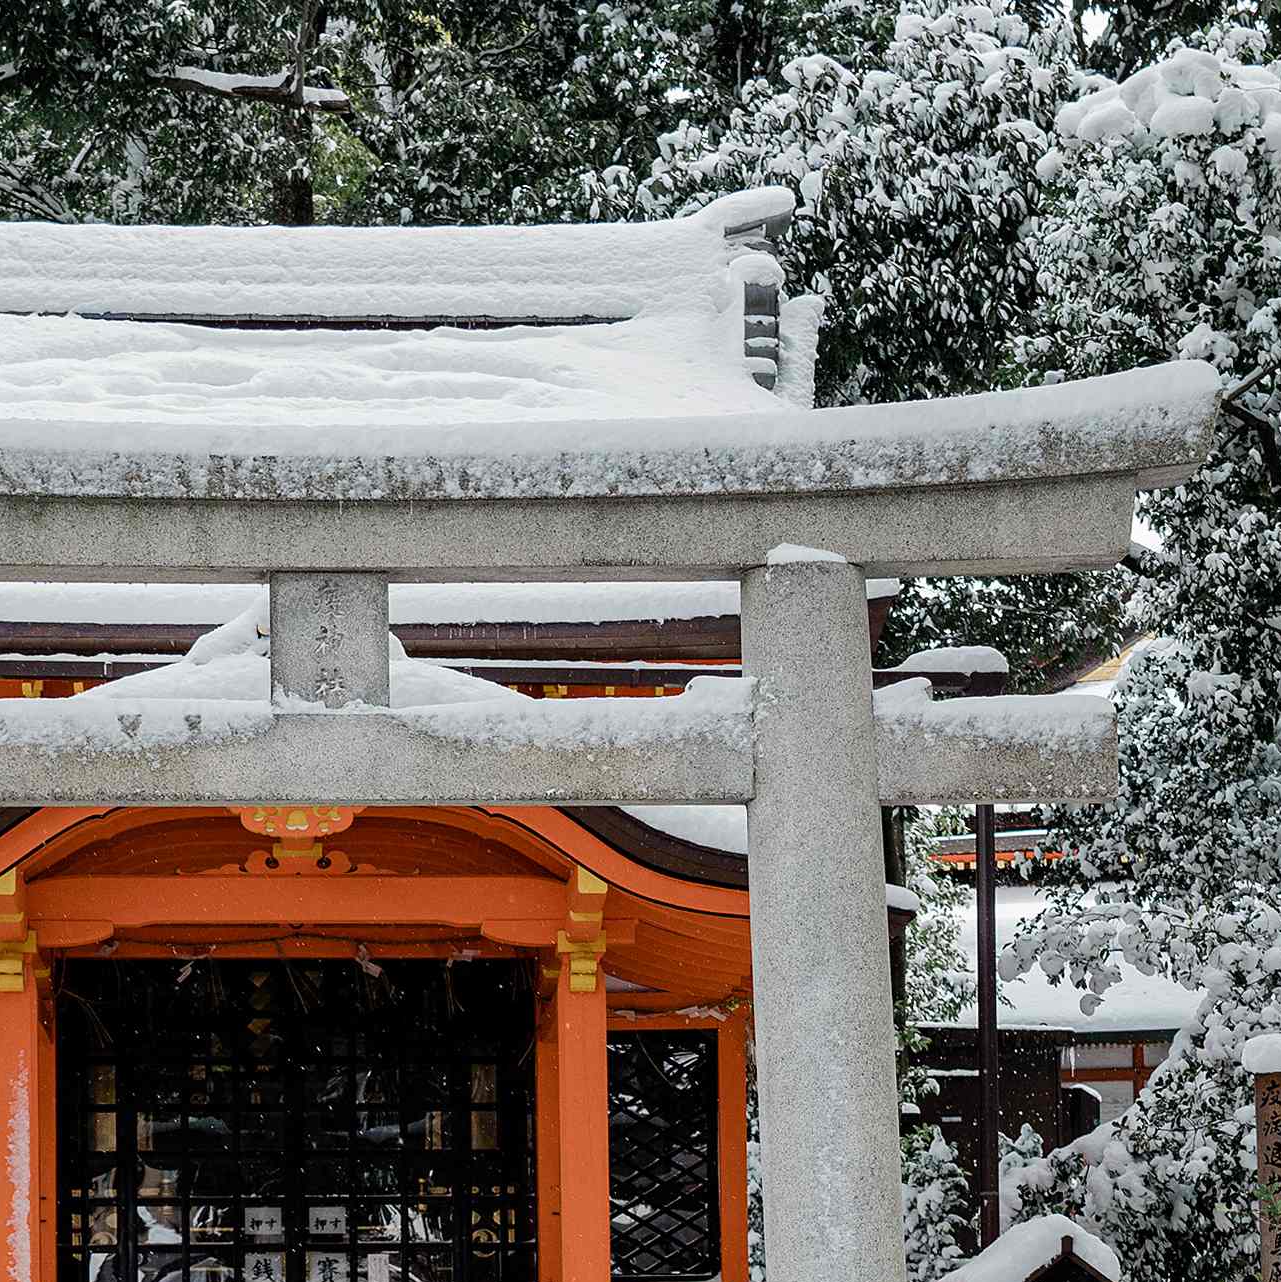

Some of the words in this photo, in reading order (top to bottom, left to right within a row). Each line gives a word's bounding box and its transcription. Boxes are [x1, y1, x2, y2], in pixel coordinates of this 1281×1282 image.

[249, 1217, 278, 1231] 押す
[313, 1216, 342, 1232] 押す
[251, 1258, 276, 1282] 銭
